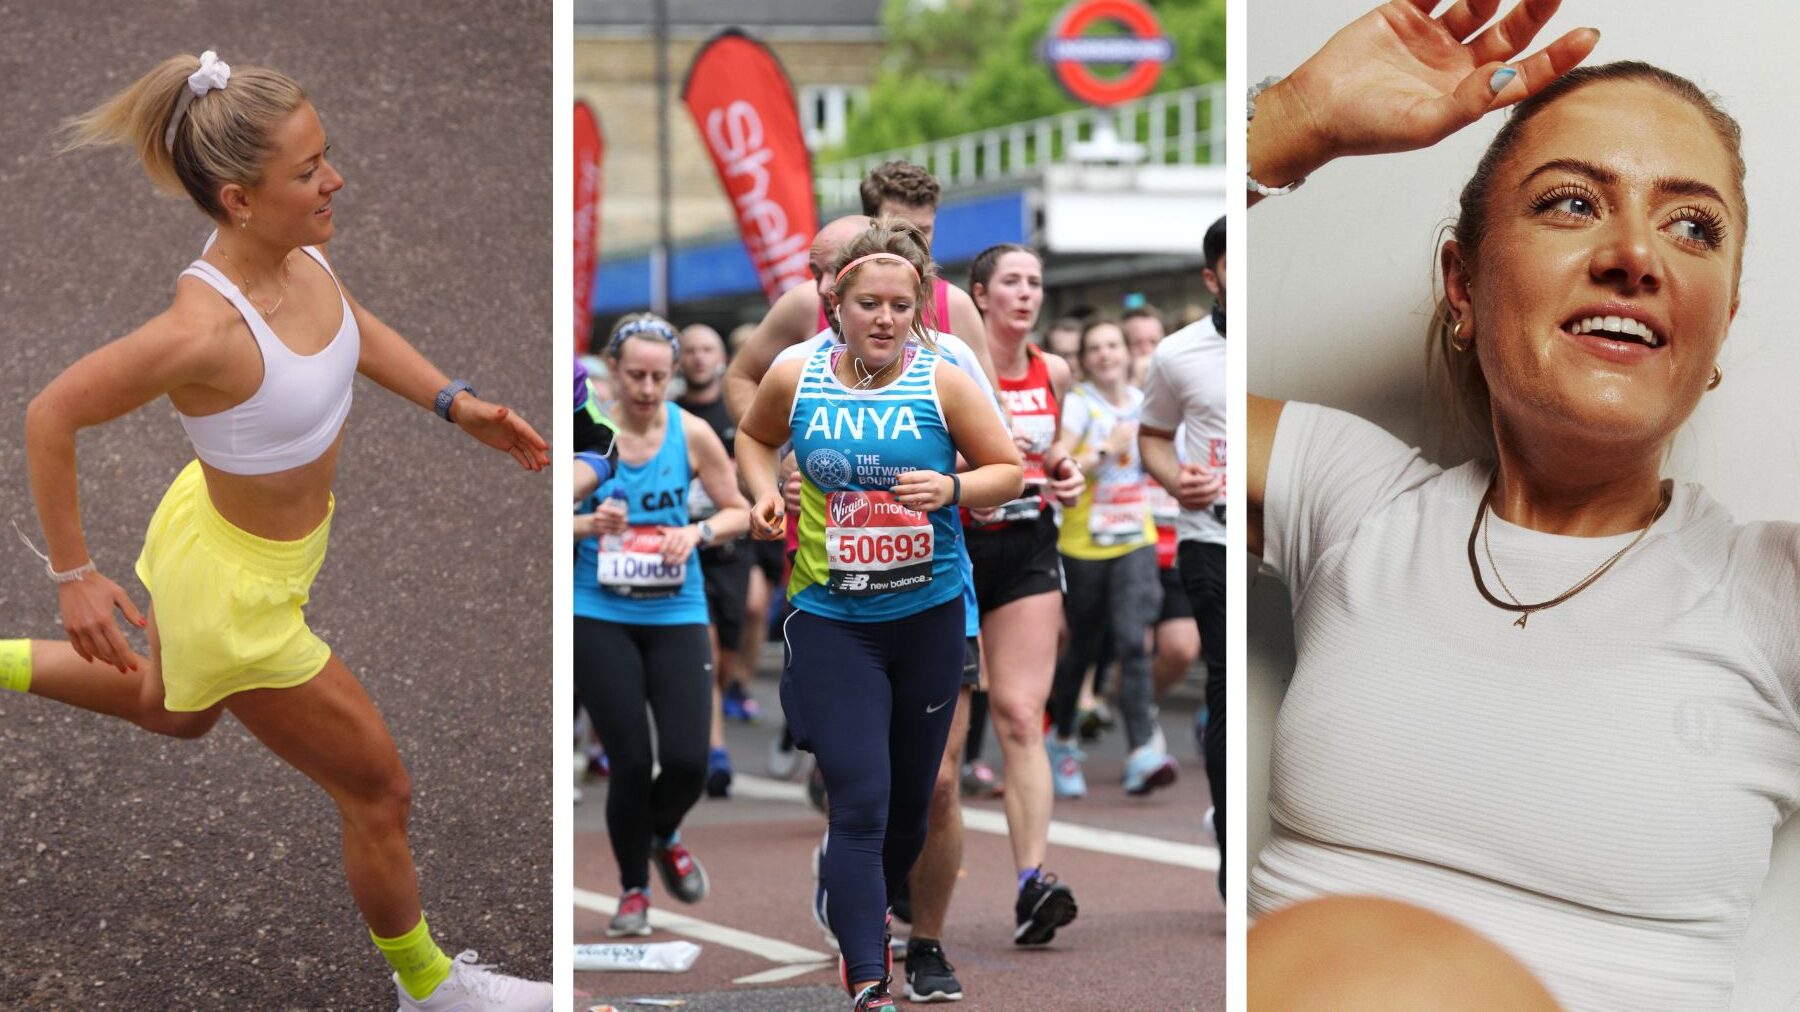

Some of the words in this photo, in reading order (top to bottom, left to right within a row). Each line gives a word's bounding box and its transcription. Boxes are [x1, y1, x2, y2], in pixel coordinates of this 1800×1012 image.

[804, 406, 922, 440] ANYA
[855, 454, 880, 465] THE
[641, 488, 684, 512] CAT
[832, 488, 869, 526] Virgin
[839, 532, 931, 564] 50693
[870, 581, 889, 590] new
[890, 574, 926, 588] balance
